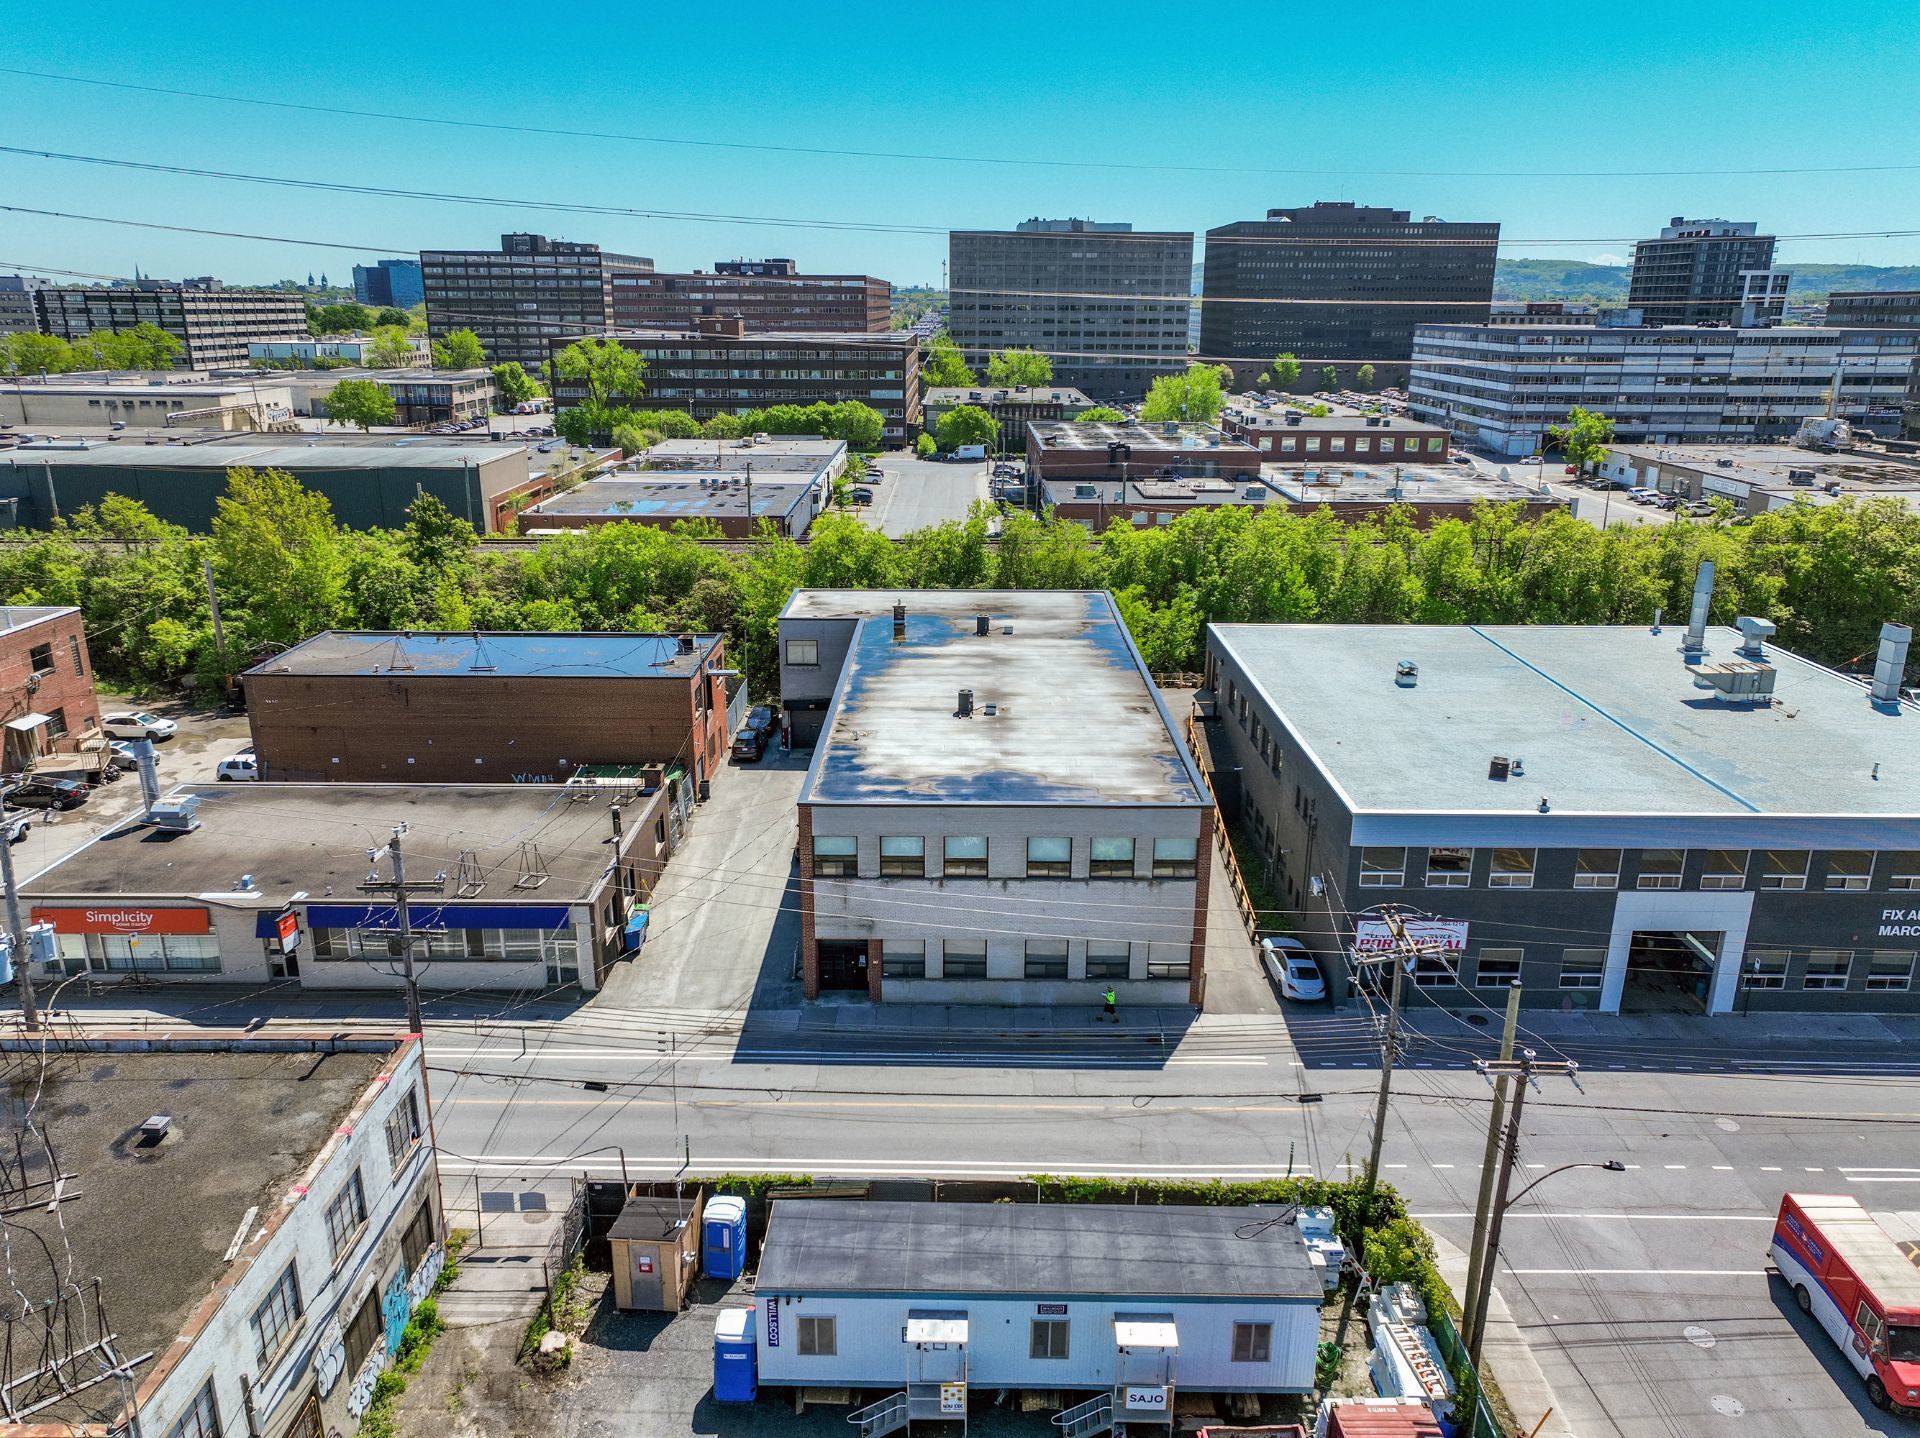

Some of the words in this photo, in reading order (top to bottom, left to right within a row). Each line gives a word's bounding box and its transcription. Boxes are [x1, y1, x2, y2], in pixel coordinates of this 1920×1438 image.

[86, 911, 153, 925] Simplicity
[1882, 910, 1905, 920] FIX
[1906, 910, 1920, 920] A
[769, 1301, 778, 1346] WILLSCOT
[1130, 1394, 1164, 1403] SAJO
